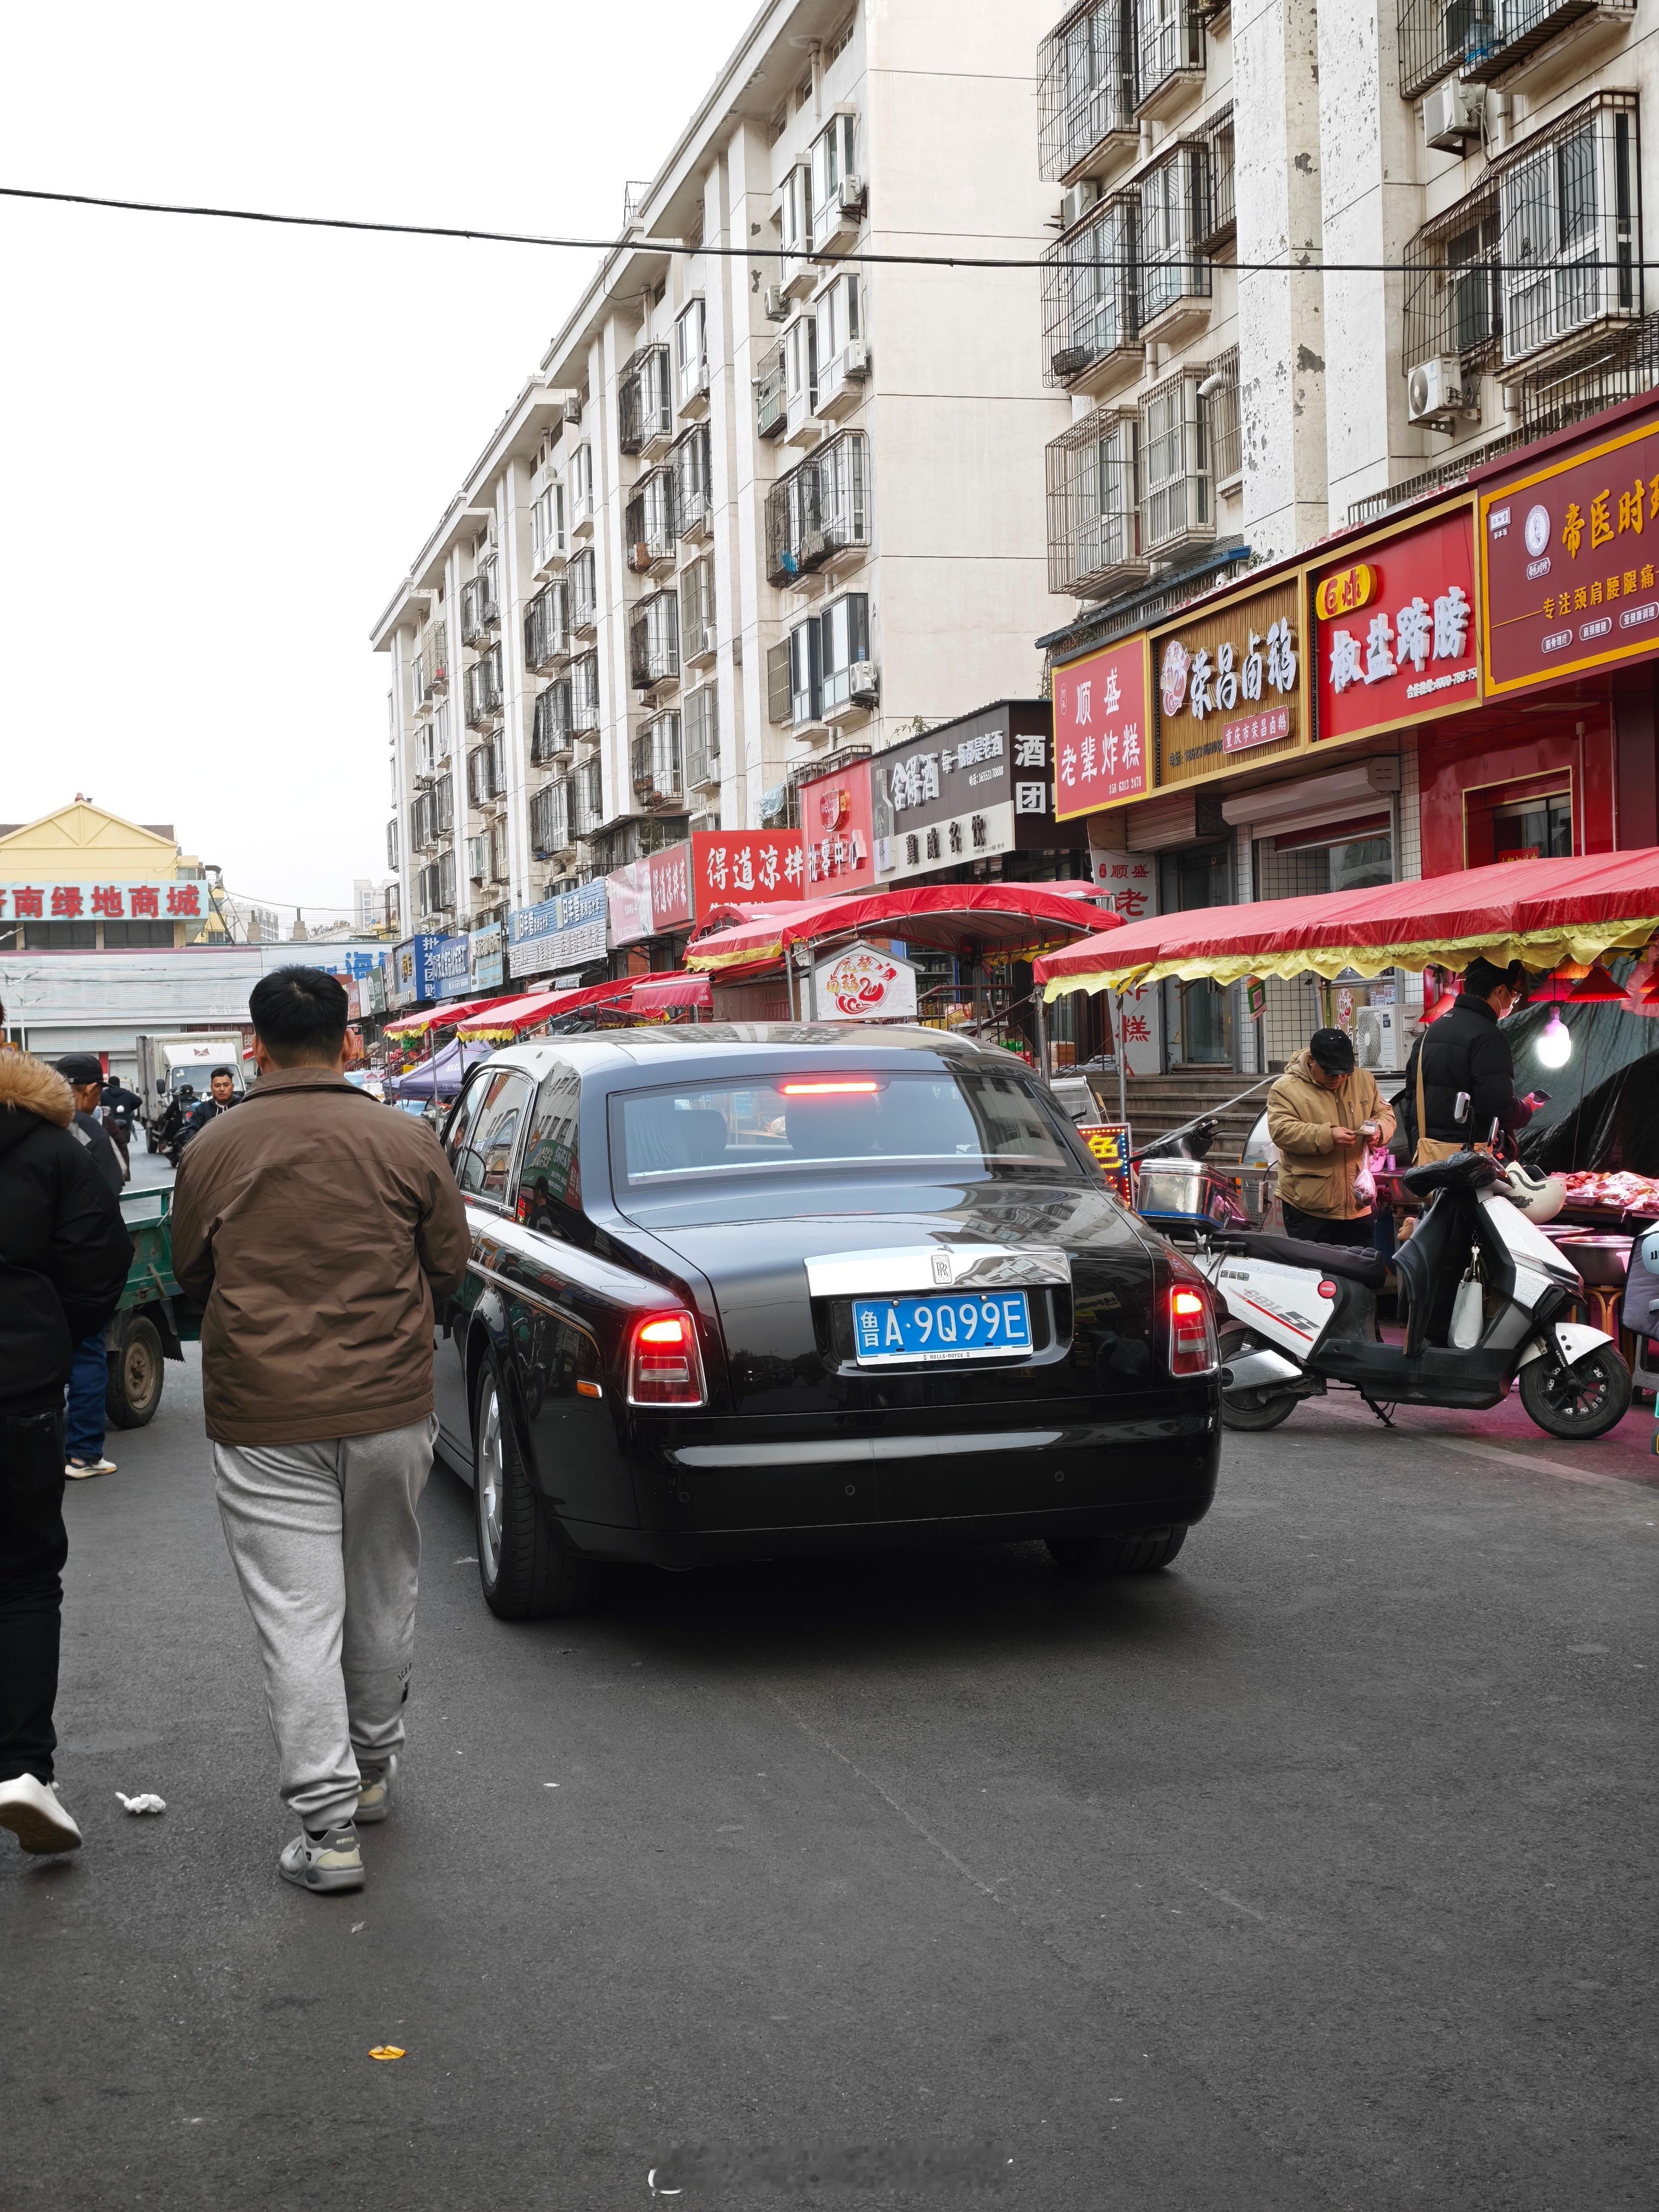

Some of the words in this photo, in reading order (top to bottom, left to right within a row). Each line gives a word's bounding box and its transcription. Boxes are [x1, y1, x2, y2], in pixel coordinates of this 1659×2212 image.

[1543, 564, 1655, 619] 专注颈肩腰腿痛
[1329, 586, 1471, 694] 椒盐蹄膀
[1190, 616, 1297, 720] 荣昌卤鹅
[1075, 666, 1122, 726] 顺盛
[1014, 734, 1055, 767] 酒
[1225, 711, 1286, 748] 重庆市荣昌卤鹅
[1061, 722, 1141, 786] 老辈炸糕
[1015, 782, 1055, 814] 团
[1109, 784, 1117, 795] 158
[653, 858, 687, 914] 得道凉拌菜
[706, 844, 804, 891] 得道凉拌
[1110, 864, 1151, 879] 顺盛
[1116, 887, 1149, 916] 老
[860, 1300, 1026, 1347] 鲁A·9Q99E
